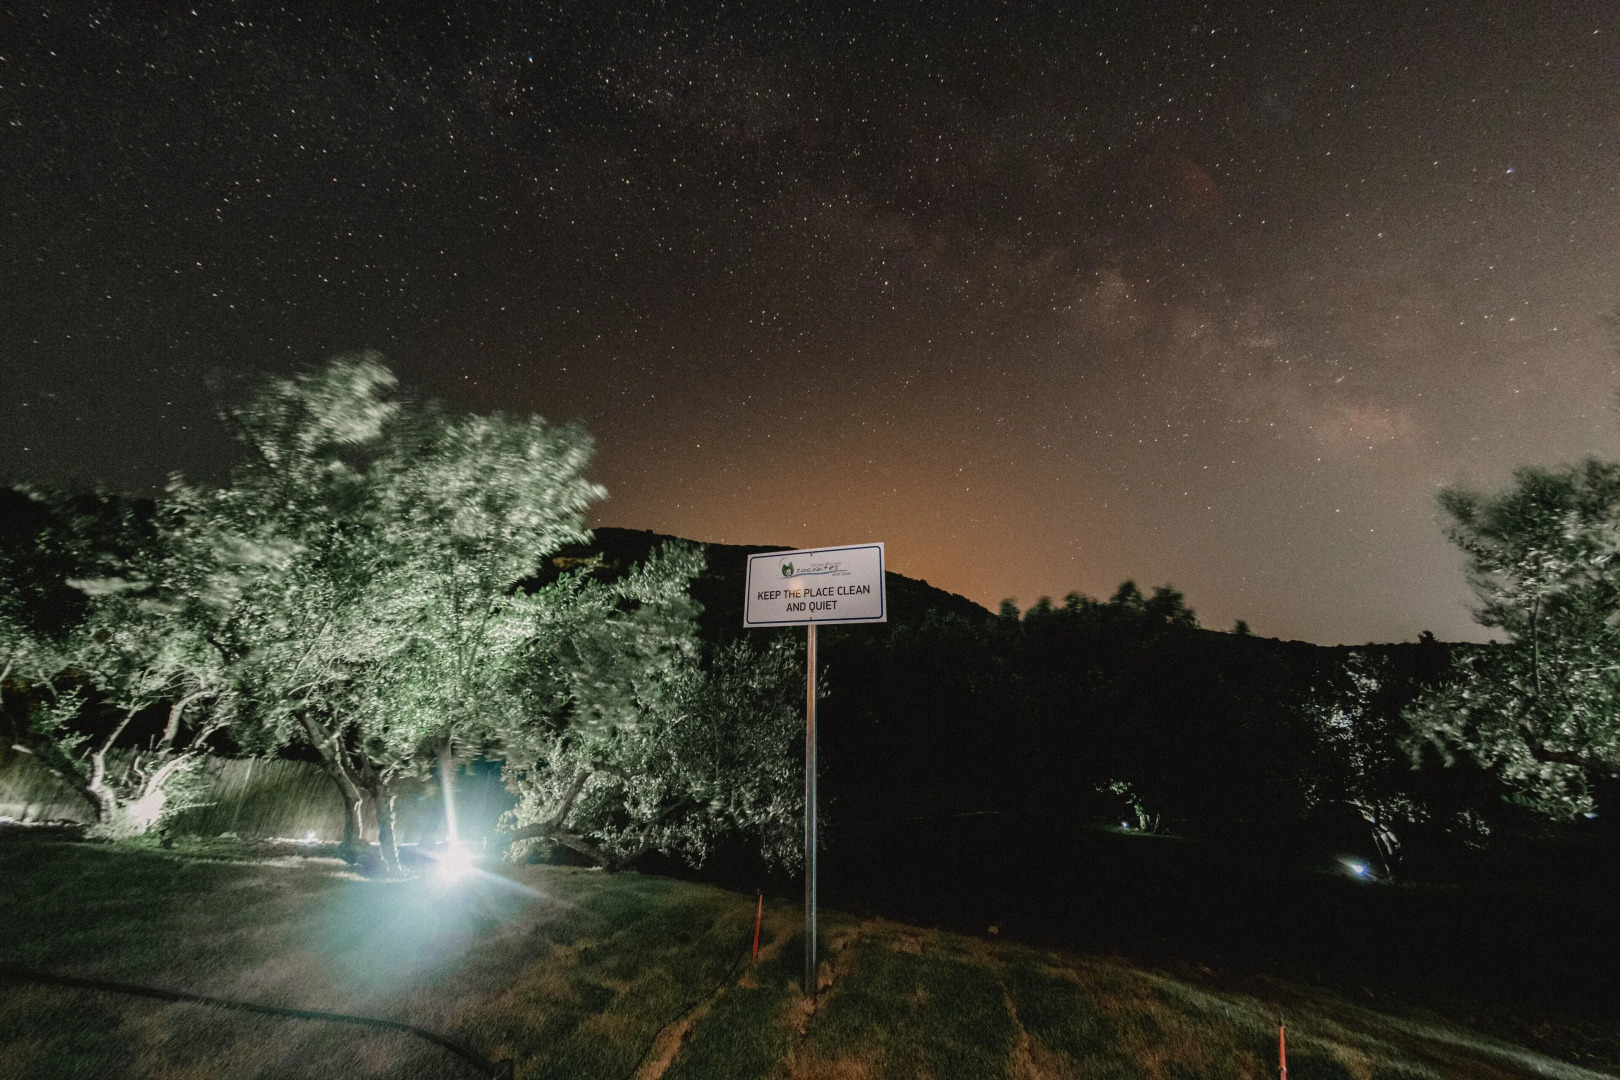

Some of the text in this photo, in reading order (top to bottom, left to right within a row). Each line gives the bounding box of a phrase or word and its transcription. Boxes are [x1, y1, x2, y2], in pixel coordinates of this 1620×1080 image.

[796, 562, 839, 573] socrates
[757, 585, 870, 600] KEEP THE PLACE CLEAN
[786, 600, 838, 612] AND QUIET
